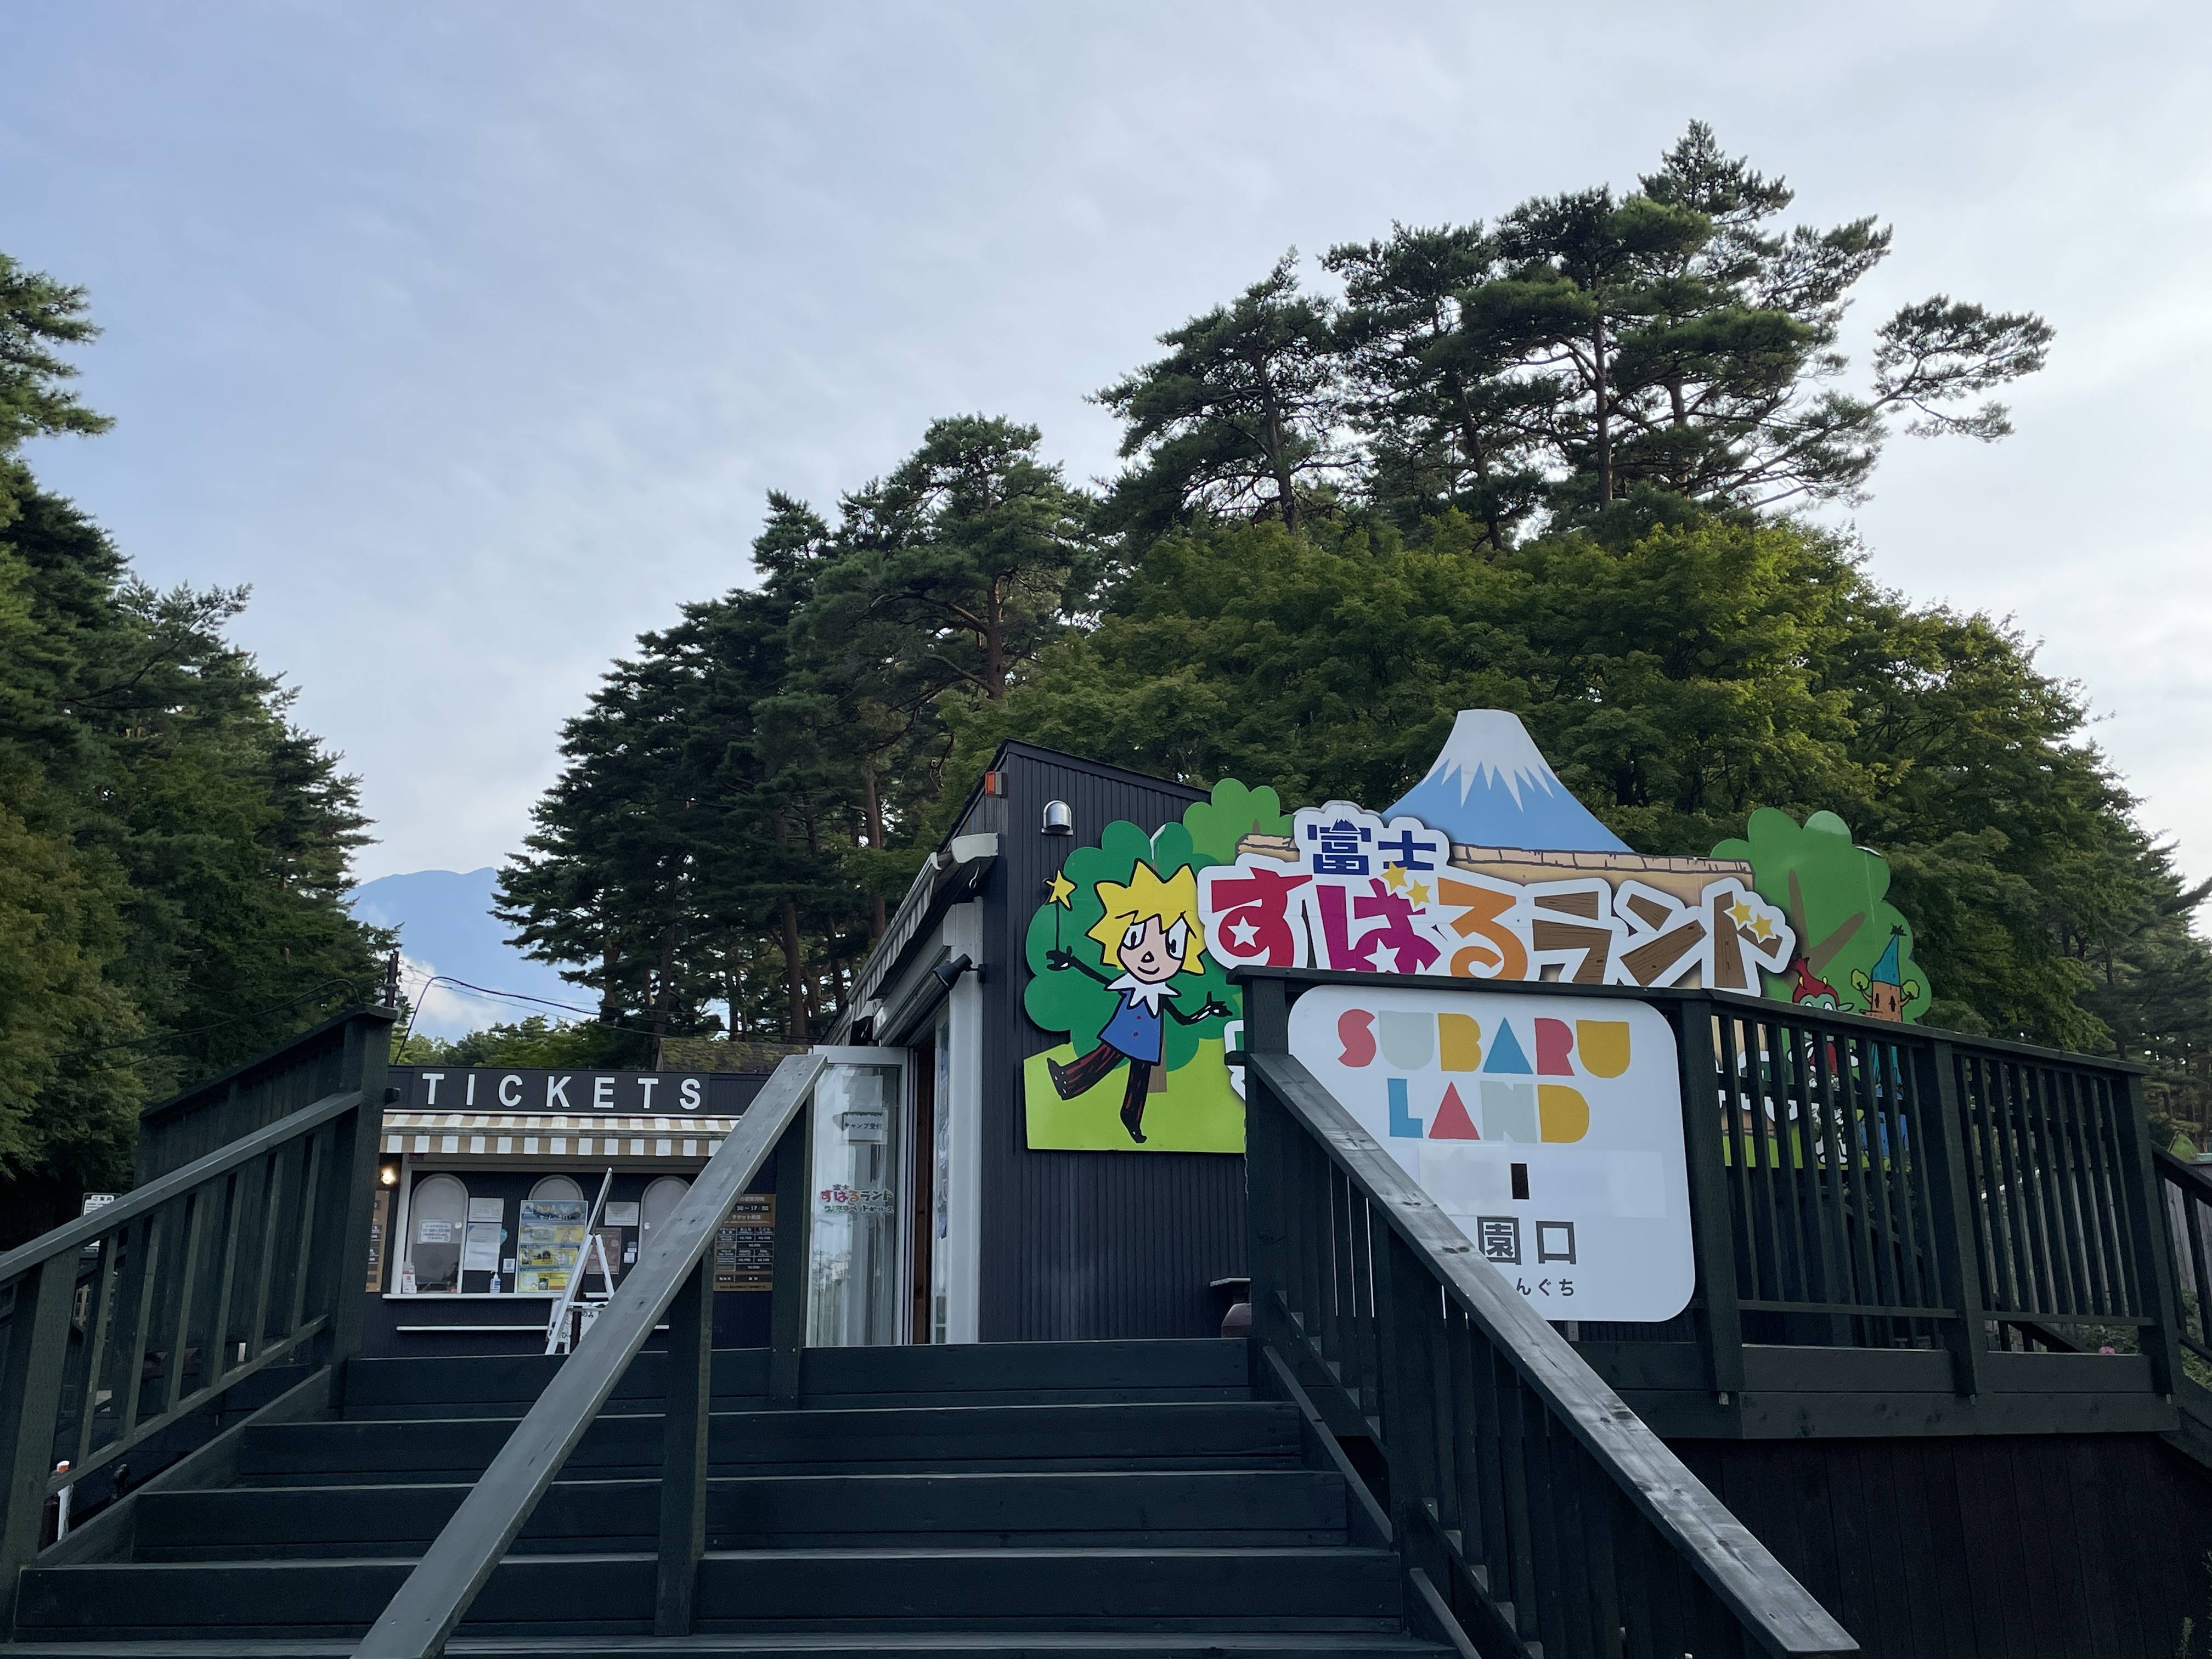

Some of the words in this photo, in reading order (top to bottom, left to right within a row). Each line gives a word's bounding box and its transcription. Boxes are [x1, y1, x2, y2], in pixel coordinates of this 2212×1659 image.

[1308, 818, 1437, 876] 富士
[1211, 866, 1780, 989] すばるランド
[1337, 1008, 1632, 1079] SUBARU
[422, 1073, 701, 1110] TICKETS
[1387, 1078, 1590, 1143] LAND
[821, 1189, 894, 1203] すばるランド
